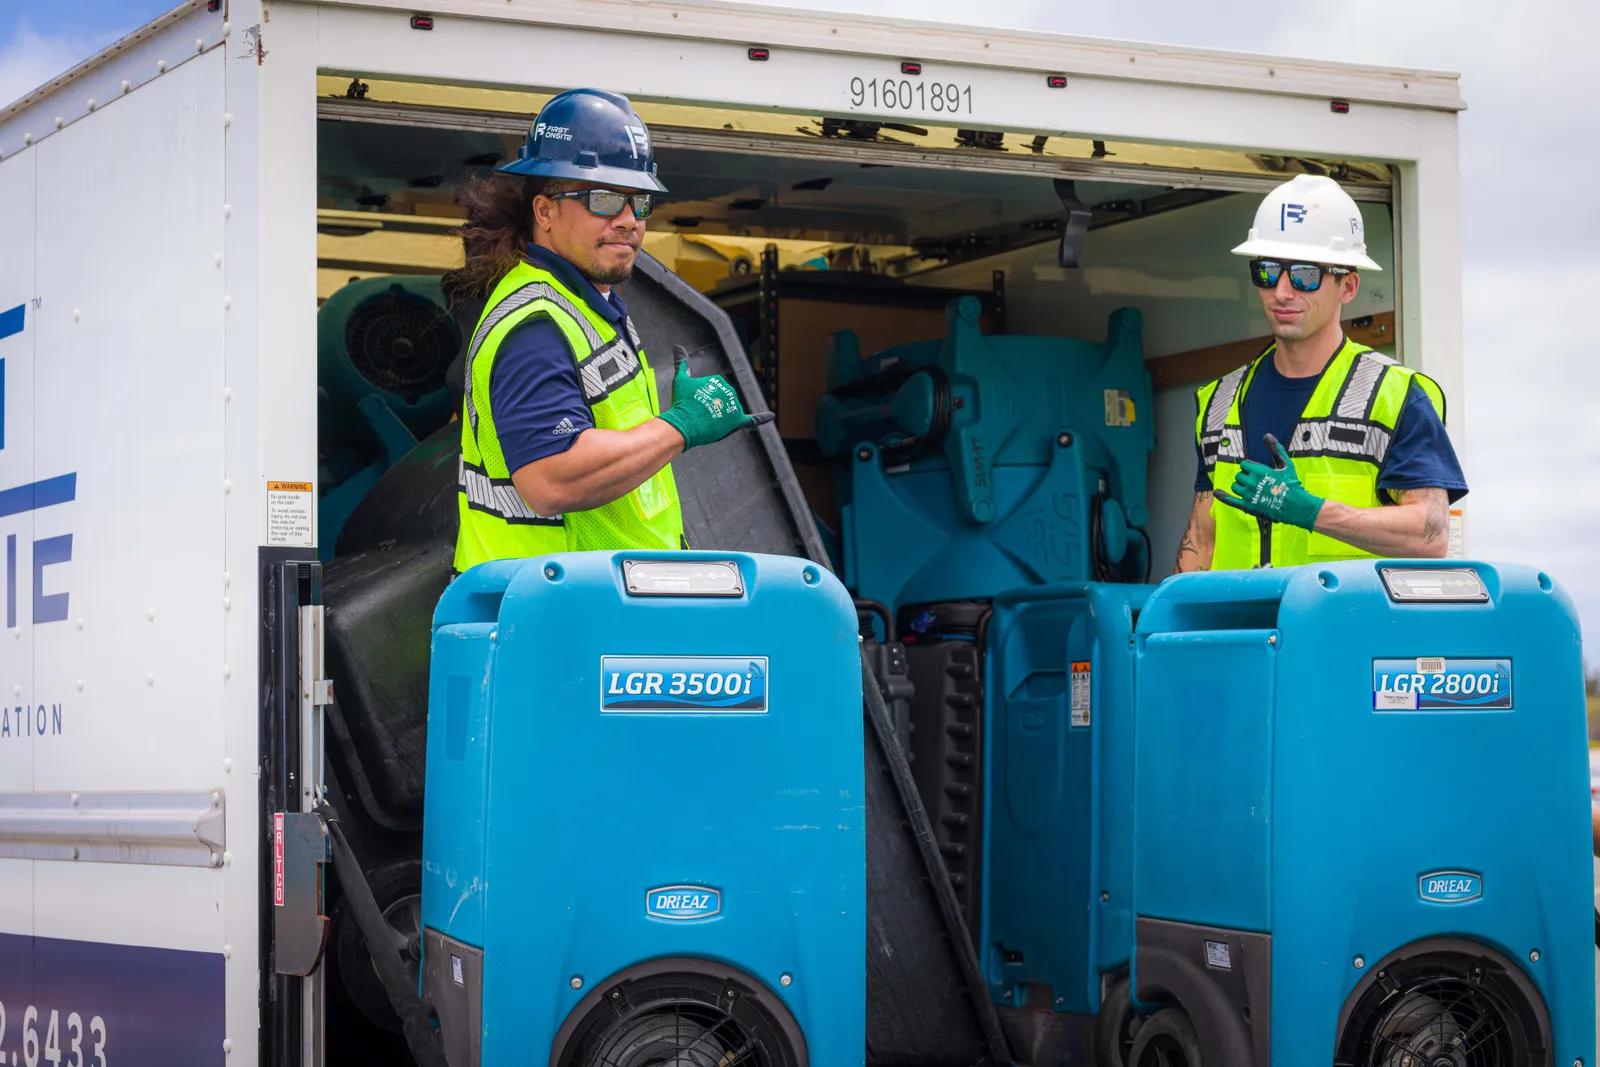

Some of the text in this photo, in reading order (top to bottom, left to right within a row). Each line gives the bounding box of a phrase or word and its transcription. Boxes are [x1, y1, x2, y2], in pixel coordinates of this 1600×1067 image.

[851, 77, 971, 114] 91601891
[545, 132, 573, 141] ONSITE
[709, 377, 738, 412] MaxiFlex
[608, 672, 752, 695] LGR 3500i
[1380, 674, 1500, 694] LGR 2800i
[2, 704, 61, 738] ATION
